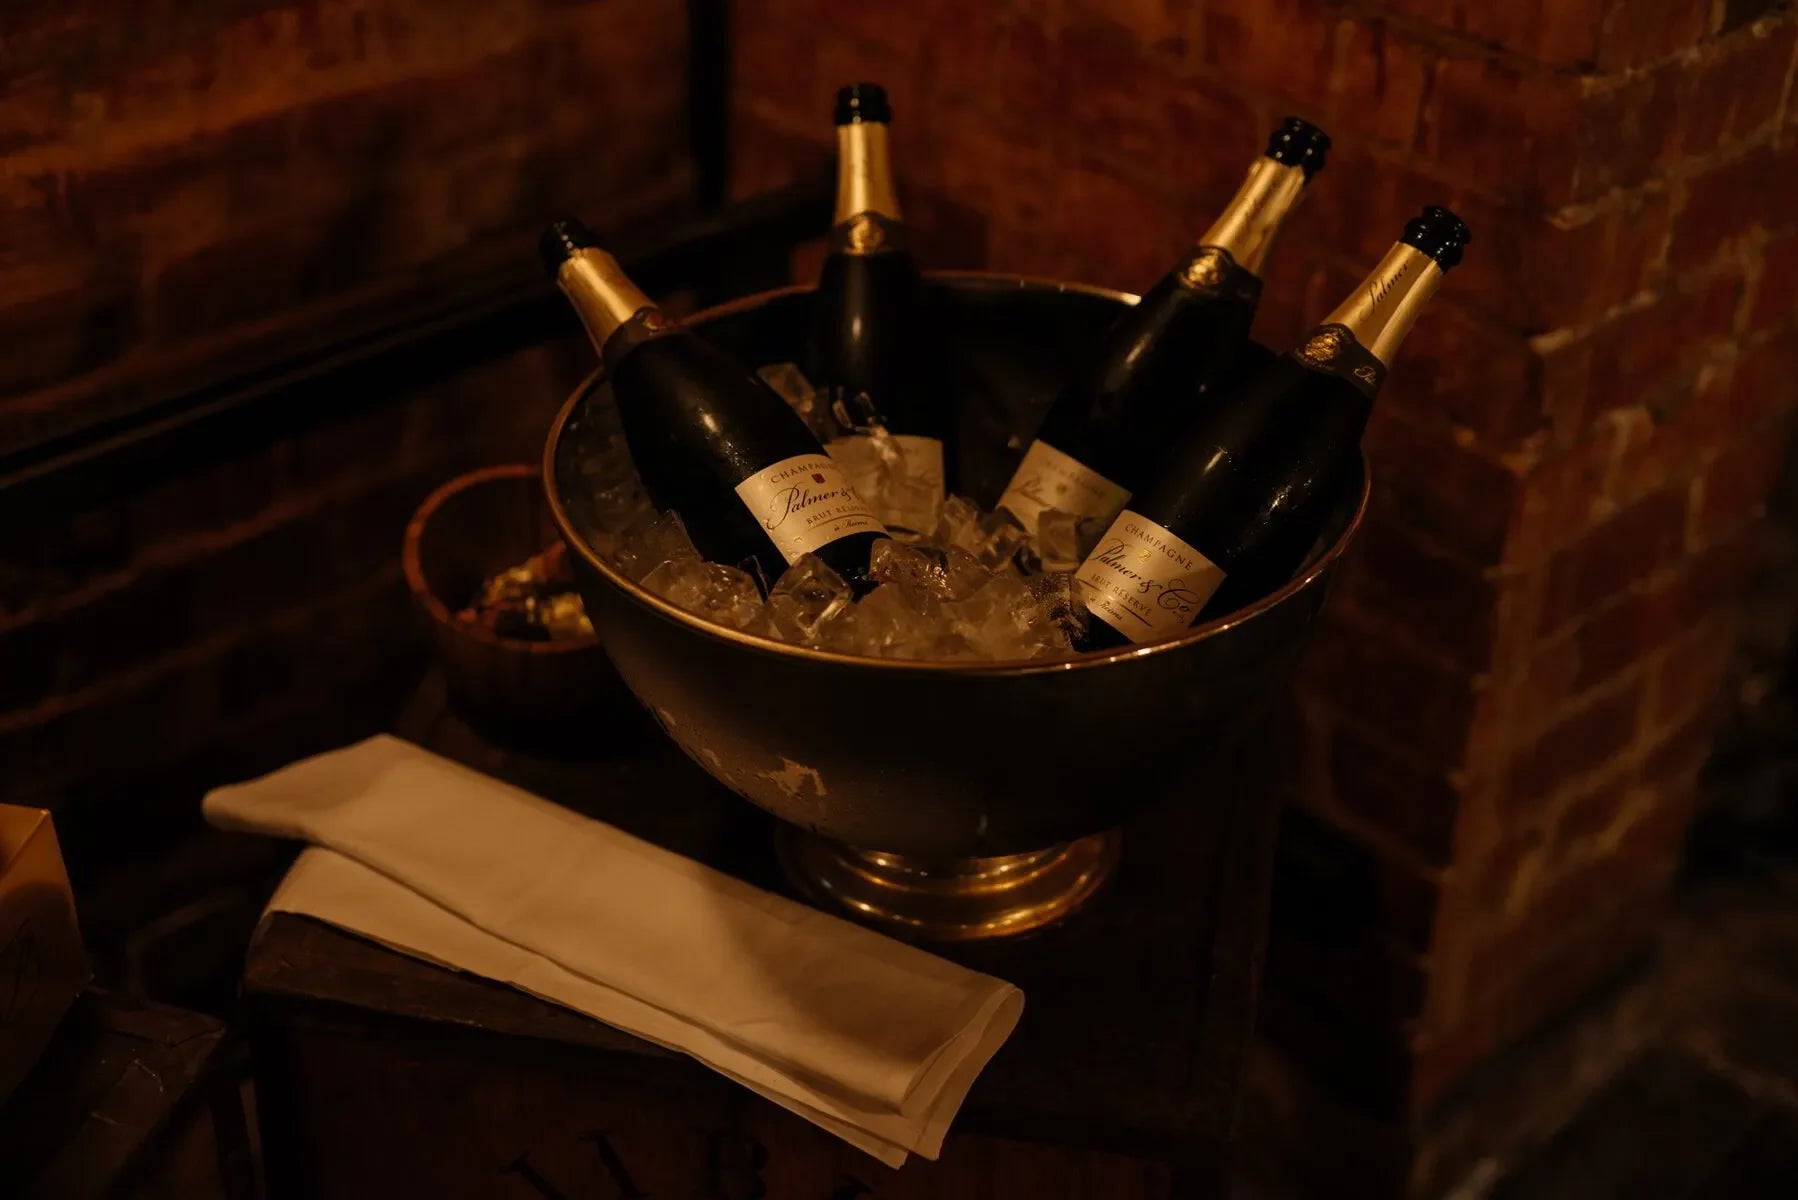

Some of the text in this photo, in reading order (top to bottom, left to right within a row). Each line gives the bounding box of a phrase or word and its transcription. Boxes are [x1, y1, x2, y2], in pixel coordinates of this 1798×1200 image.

[766, 480, 839, 531] Palmer
[805, 509, 834, 526] BRUT
[1087, 537, 1142, 580] Palmer
[1124, 522, 1194, 572] CHAMPAGNE
